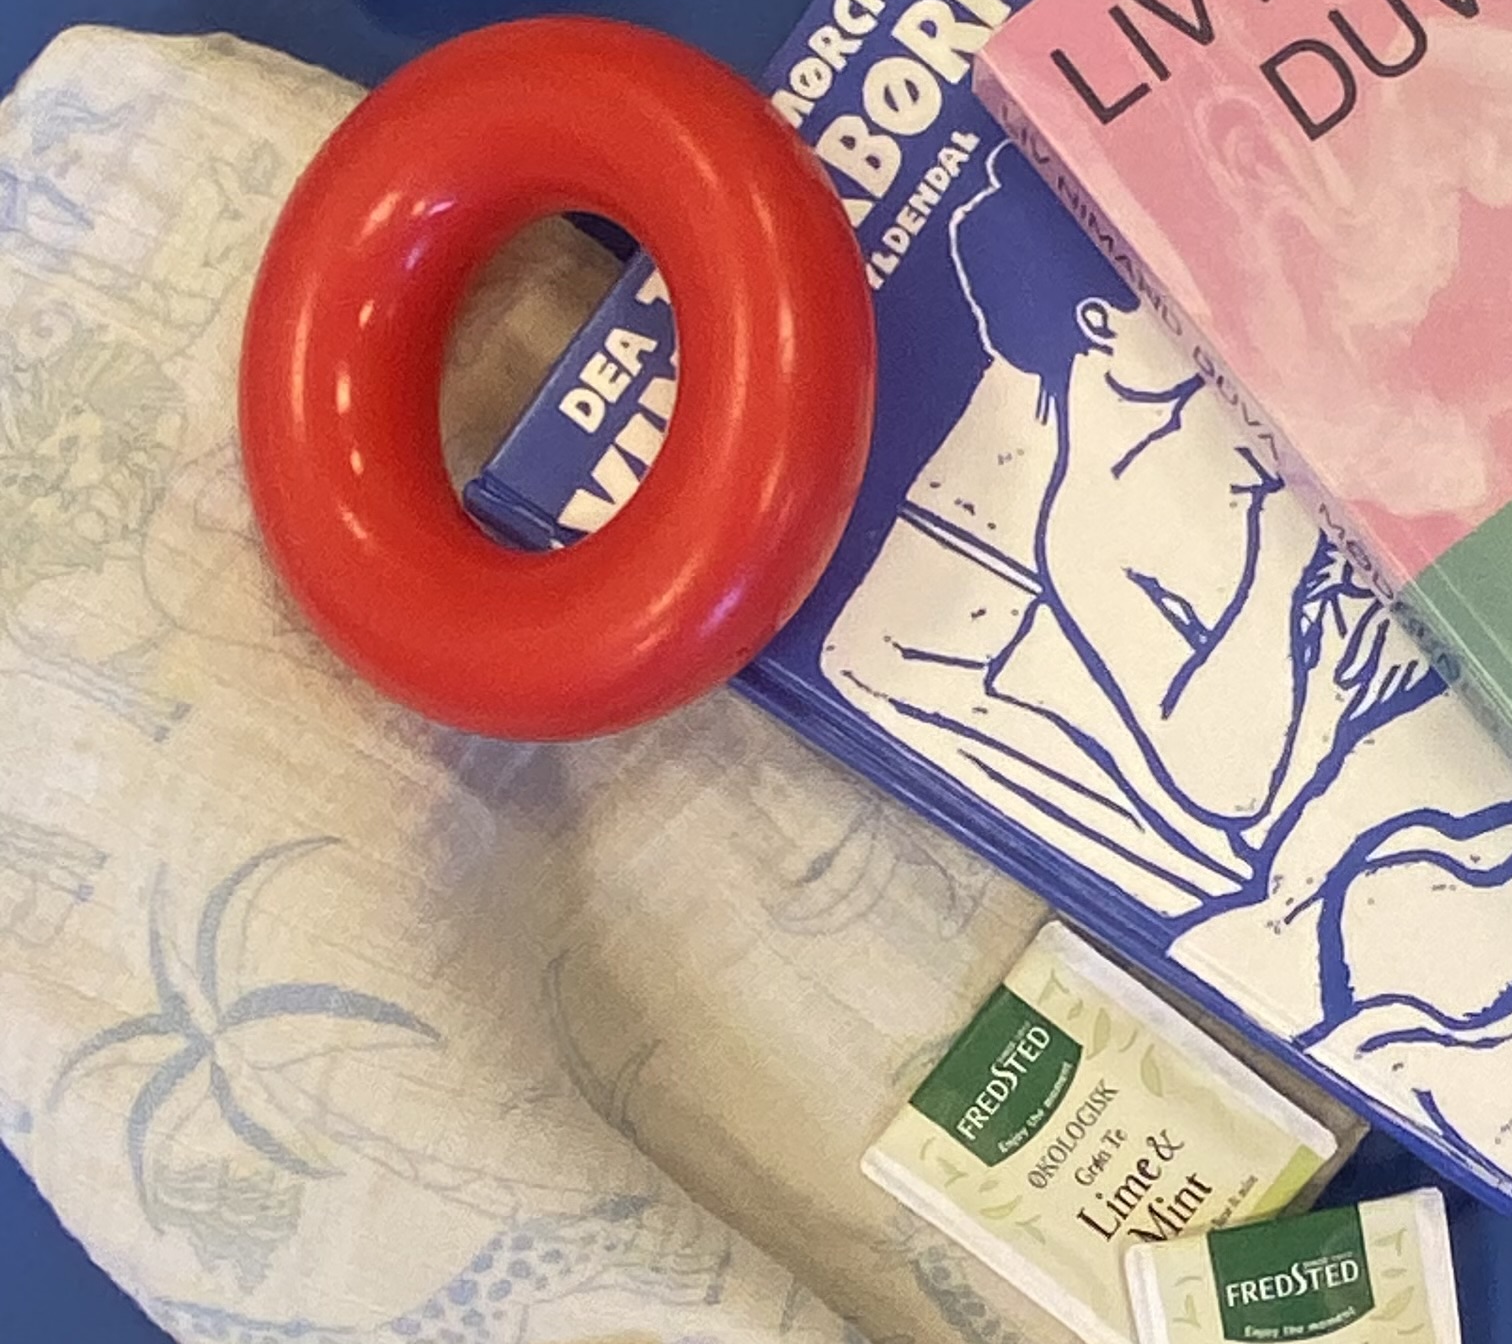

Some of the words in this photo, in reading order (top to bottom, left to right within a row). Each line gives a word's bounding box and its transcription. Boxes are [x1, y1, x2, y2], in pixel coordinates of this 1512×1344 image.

[558, 327, 658, 434] DEA
[956, 1025, 1051, 1141] FREDSTED
[1027, 1078, 1119, 1190] ØKOLOGISK
[1076, 1157, 1162, 1242] Lime
[1146, 1128, 1186, 1162] &
[1225, 1259, 1359, 1307] FREDSTED
